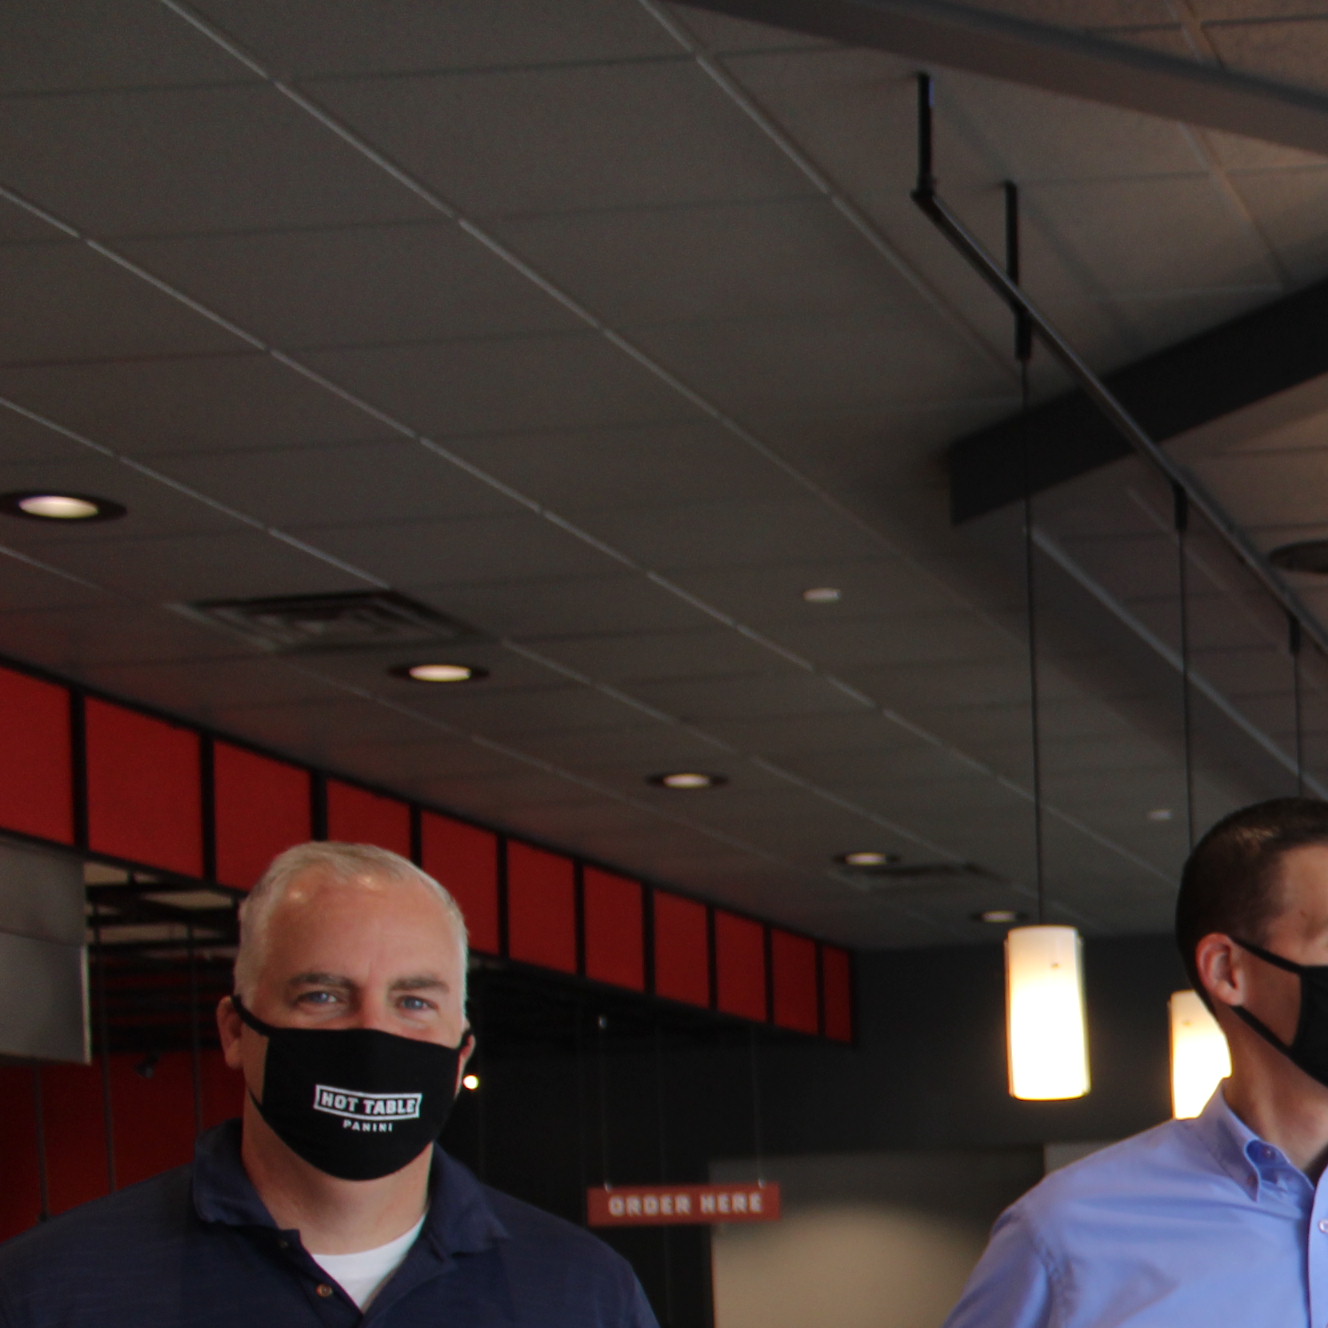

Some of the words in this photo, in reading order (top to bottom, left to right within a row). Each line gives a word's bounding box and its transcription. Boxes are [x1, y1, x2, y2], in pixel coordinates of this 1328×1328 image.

[321, 1091, 358, 1111] HOT
[363, 1098, 416, 1115] TABLE
[343, 1119, 393, 1132] PANINI
[608, 1194, 691, 1217] ORDER
[700, 1192, 763, 1214] HERE
